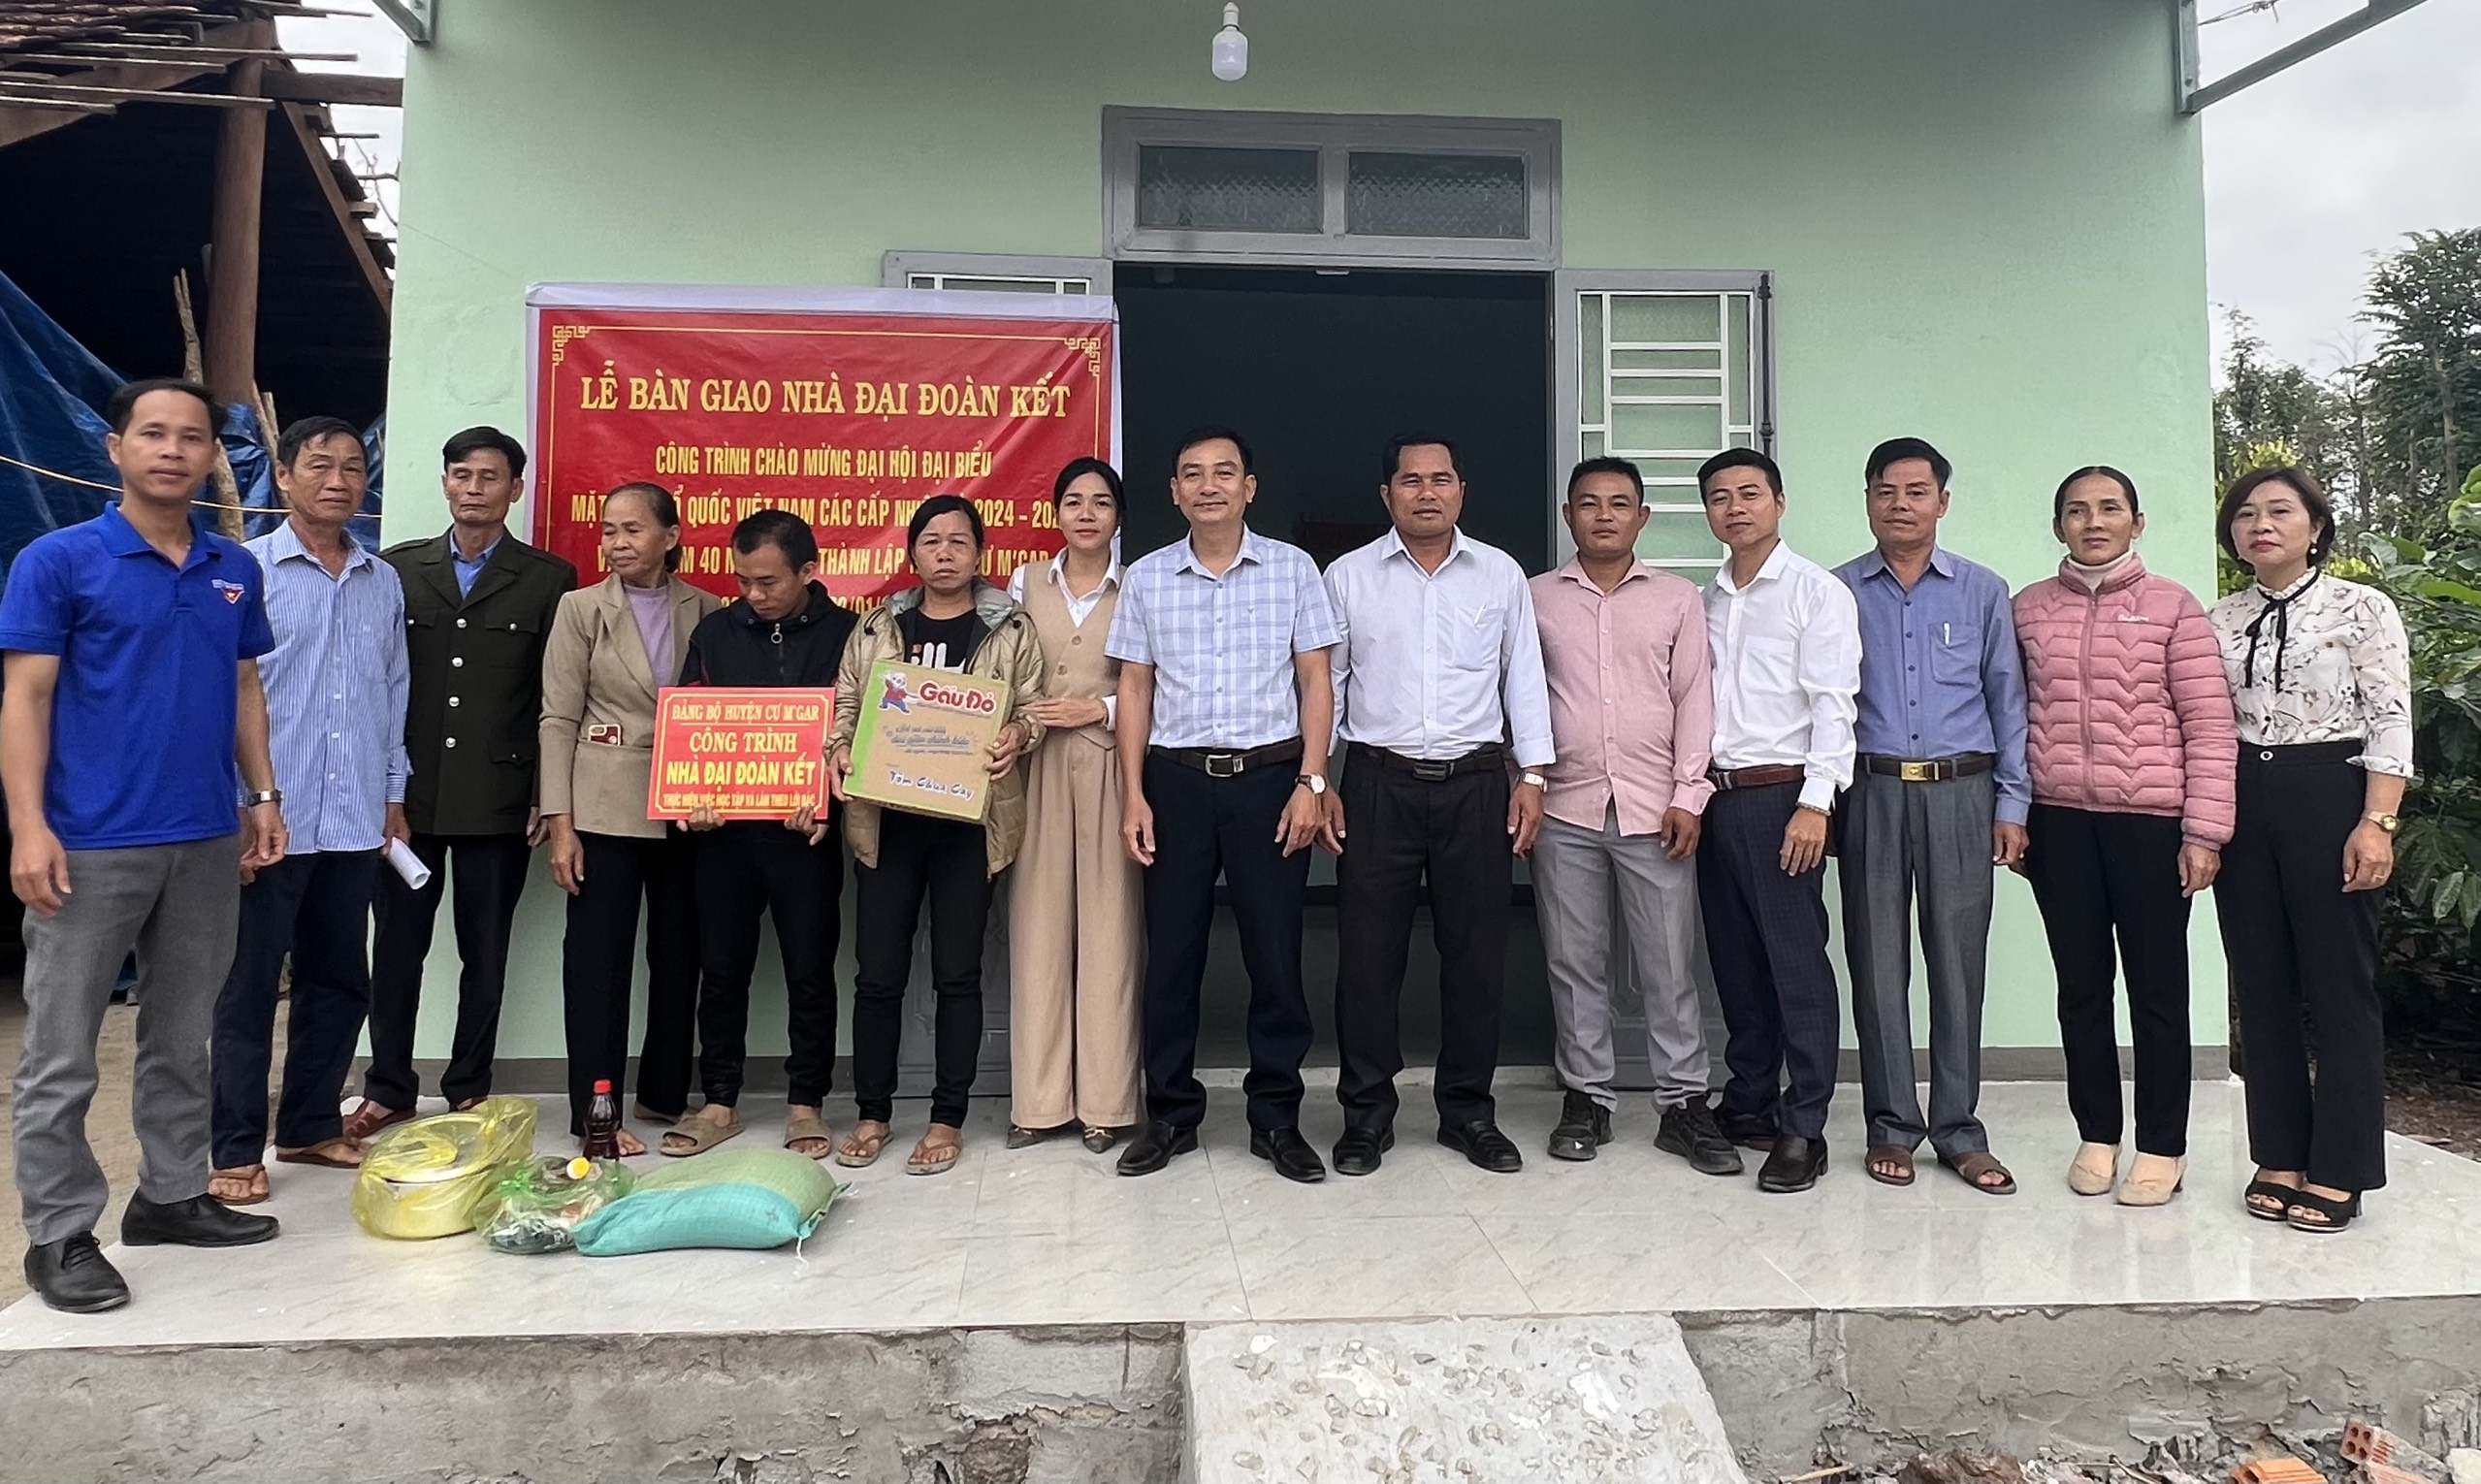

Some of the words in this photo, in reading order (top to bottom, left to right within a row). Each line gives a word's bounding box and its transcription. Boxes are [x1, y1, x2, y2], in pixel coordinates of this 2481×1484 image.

[580, 359, 619, 410] LỄ
[628, 369, 692, 411] BÀN
[700, 378, 772, 413] GIAO
[781, 371, 846, 414] NHÀ
[854, 382, 909, 422] ĐẠI
[918, 374, 1001, 417] ĐOÀN
[1010, 371, 1072, 417] KẾT
[656, 440, 699, 474] CÔNG
[704, 440, 751, 475] TRÌNH
[755, 441, 799, 476] CHÀO
[803, 441, 851, 477] MỪNG
[856, 449, 884, 484] ĐẠI
[889, 444, 917, 484] HỘI
[922, 450, 950, 485] ĐẠI
[955, 439, 992, 478] BIỂU
[687, 488, 731, 528] QUỐC
[820, 492, 852, 527] CÁC
[856, 490, 889, 527] CẤP
[974, 499, 1015, 527] 2024
[700, 546, 721, 574] 40
[819, 541, 871, 575] THÀNH
[874, 542, 905, 580] LẬP
[672, 698, 703, 721] ĐẢNG
[706, 700, 722, 724] BỘ
[724, 700, 763, 724] HUYỆN
[765, 702, 782, 721] CƯ
[919, 682, 964, 707] Gấu
[965, 690, 995, 713] Đỏ
[690, 726, 737, 753] CÔNG
[743, 726, 798, 753] TRÌNH
[666, 755, 699, 785] NHÀ
[704, 760, 732, 792] ĐẠI
[735, 756, 779, 785] ĐOÀN
[783, 752, 817, 786] KẾT
[889, 770, 913, 785] Tôm
[951, 784, 973, 799] Cay
